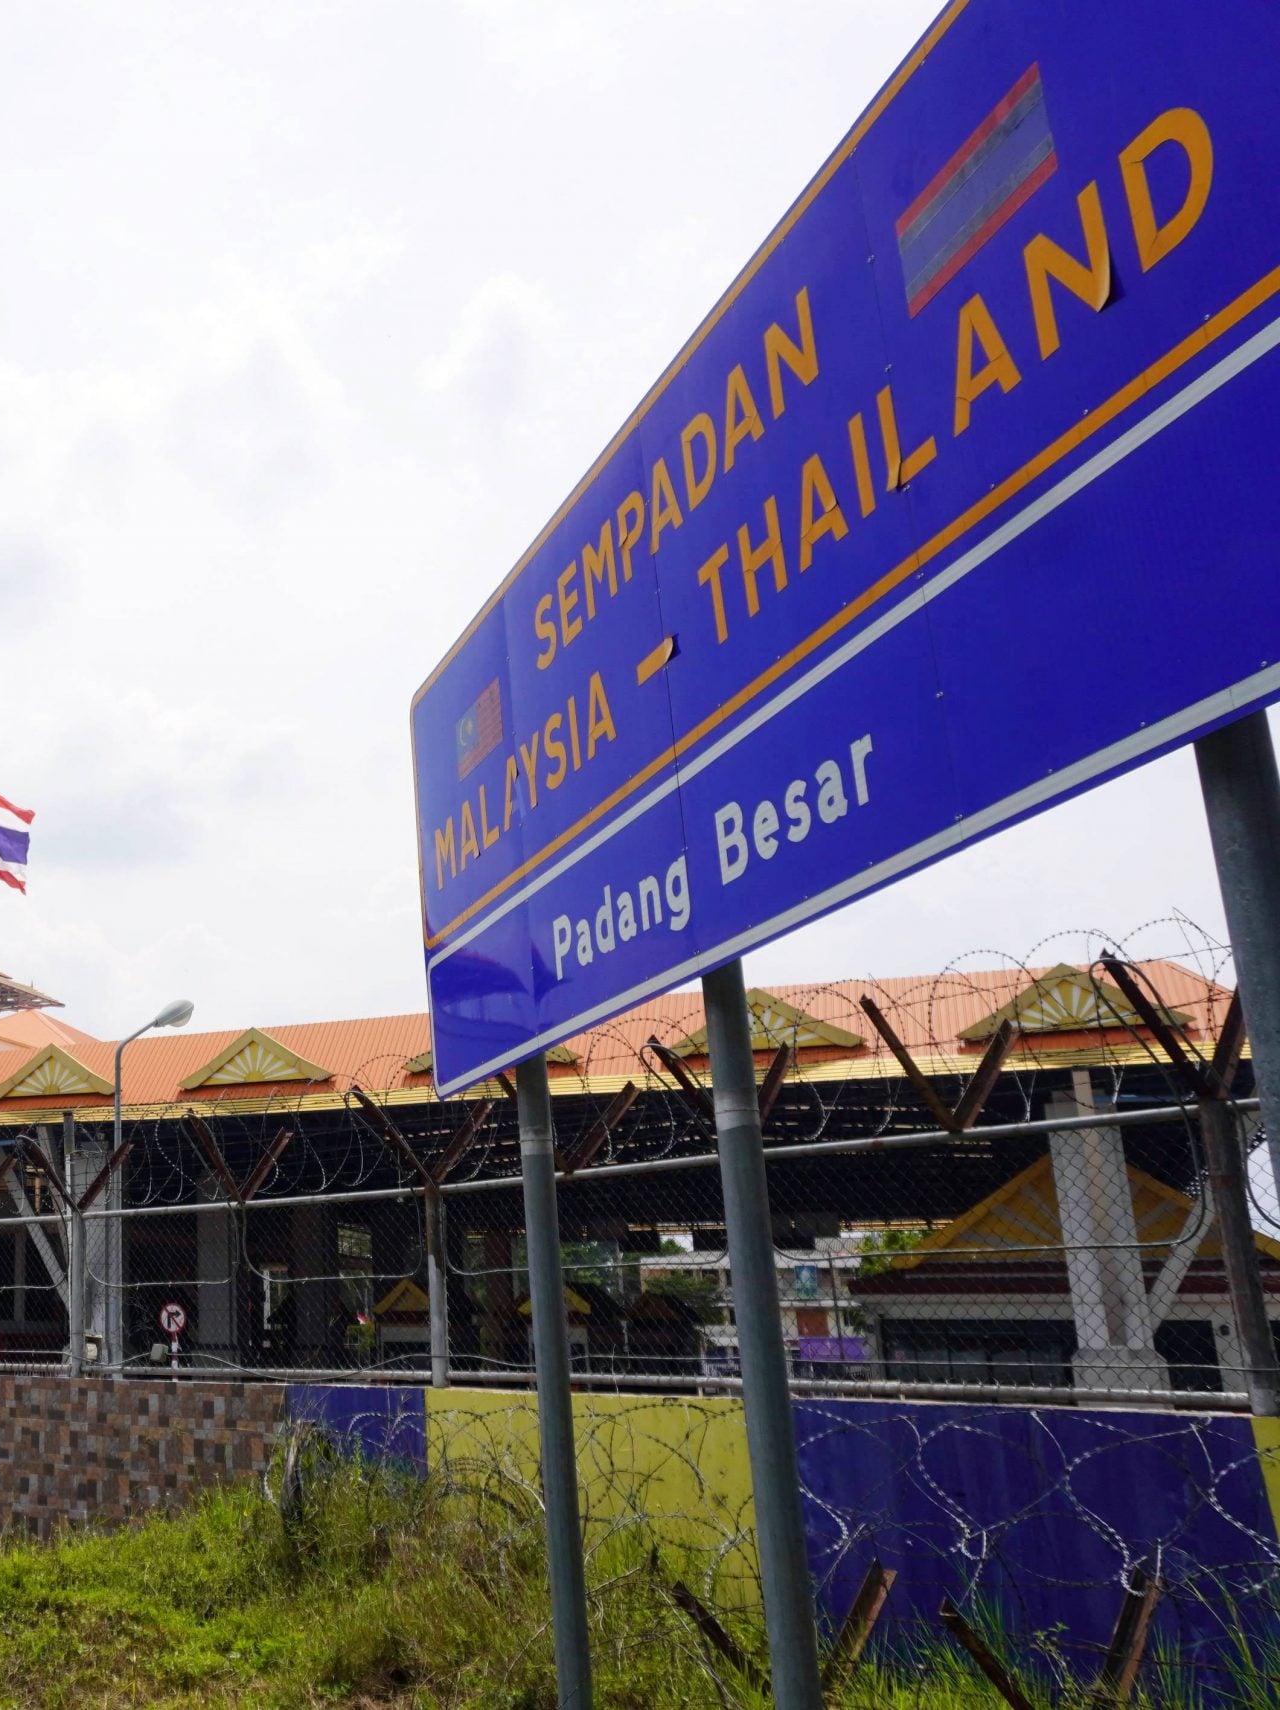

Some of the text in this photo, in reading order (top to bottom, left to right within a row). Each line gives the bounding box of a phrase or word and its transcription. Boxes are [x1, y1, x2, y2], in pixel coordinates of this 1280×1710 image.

[434, 671, 618, 889] MALAYSIA
[698, 107, 1214, 645] THAILAND
[534, 286, 819, 671] SEMPADAN
[552, 734, 873, 981] Padang Besar
